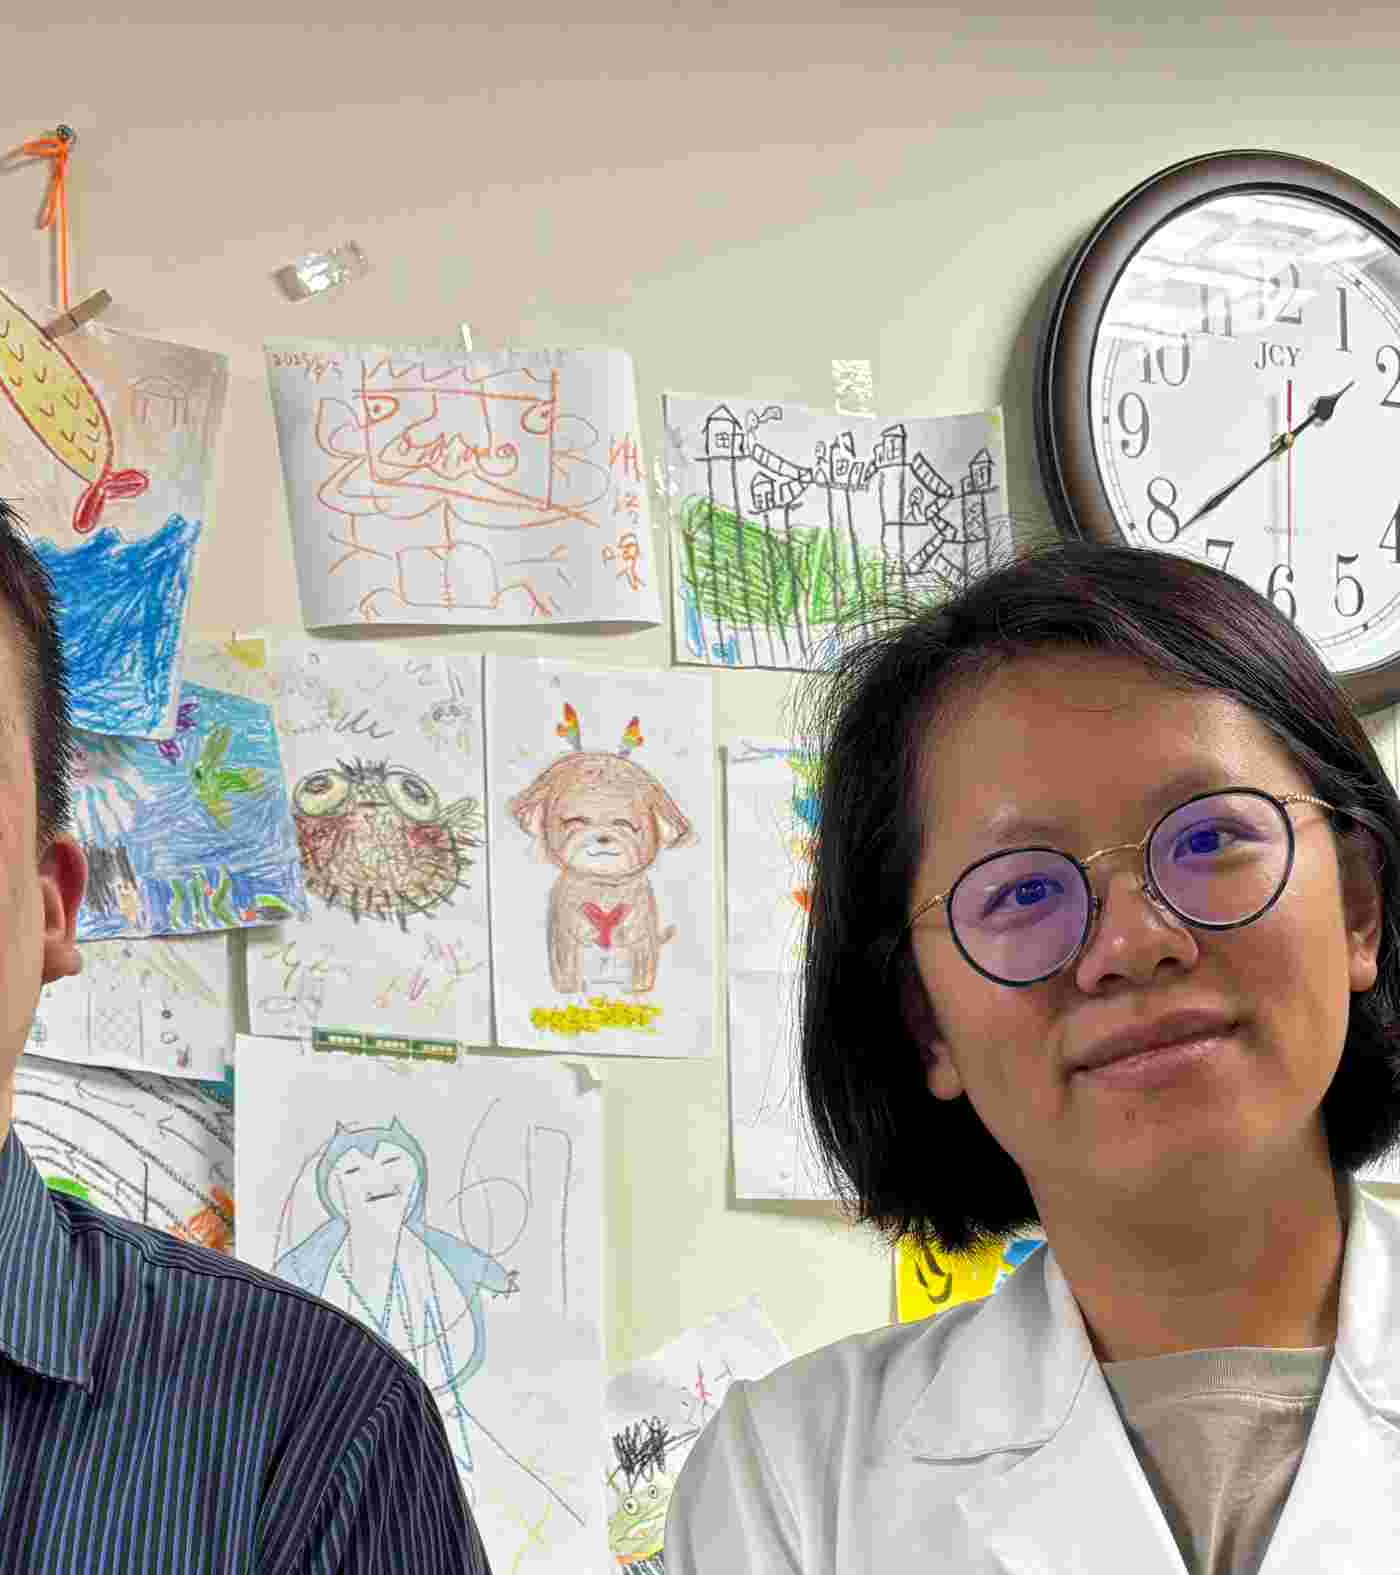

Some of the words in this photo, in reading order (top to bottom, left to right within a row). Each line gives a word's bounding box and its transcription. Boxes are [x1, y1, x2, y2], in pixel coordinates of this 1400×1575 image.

[1335, 287, 1352, 353] 1
[1117, 392, 1150, 458] 9
[1146, 477, 1181, 544] 8
[1266, 563, 1296, 623] 6
[1334, 553, 1364, 617] 5
